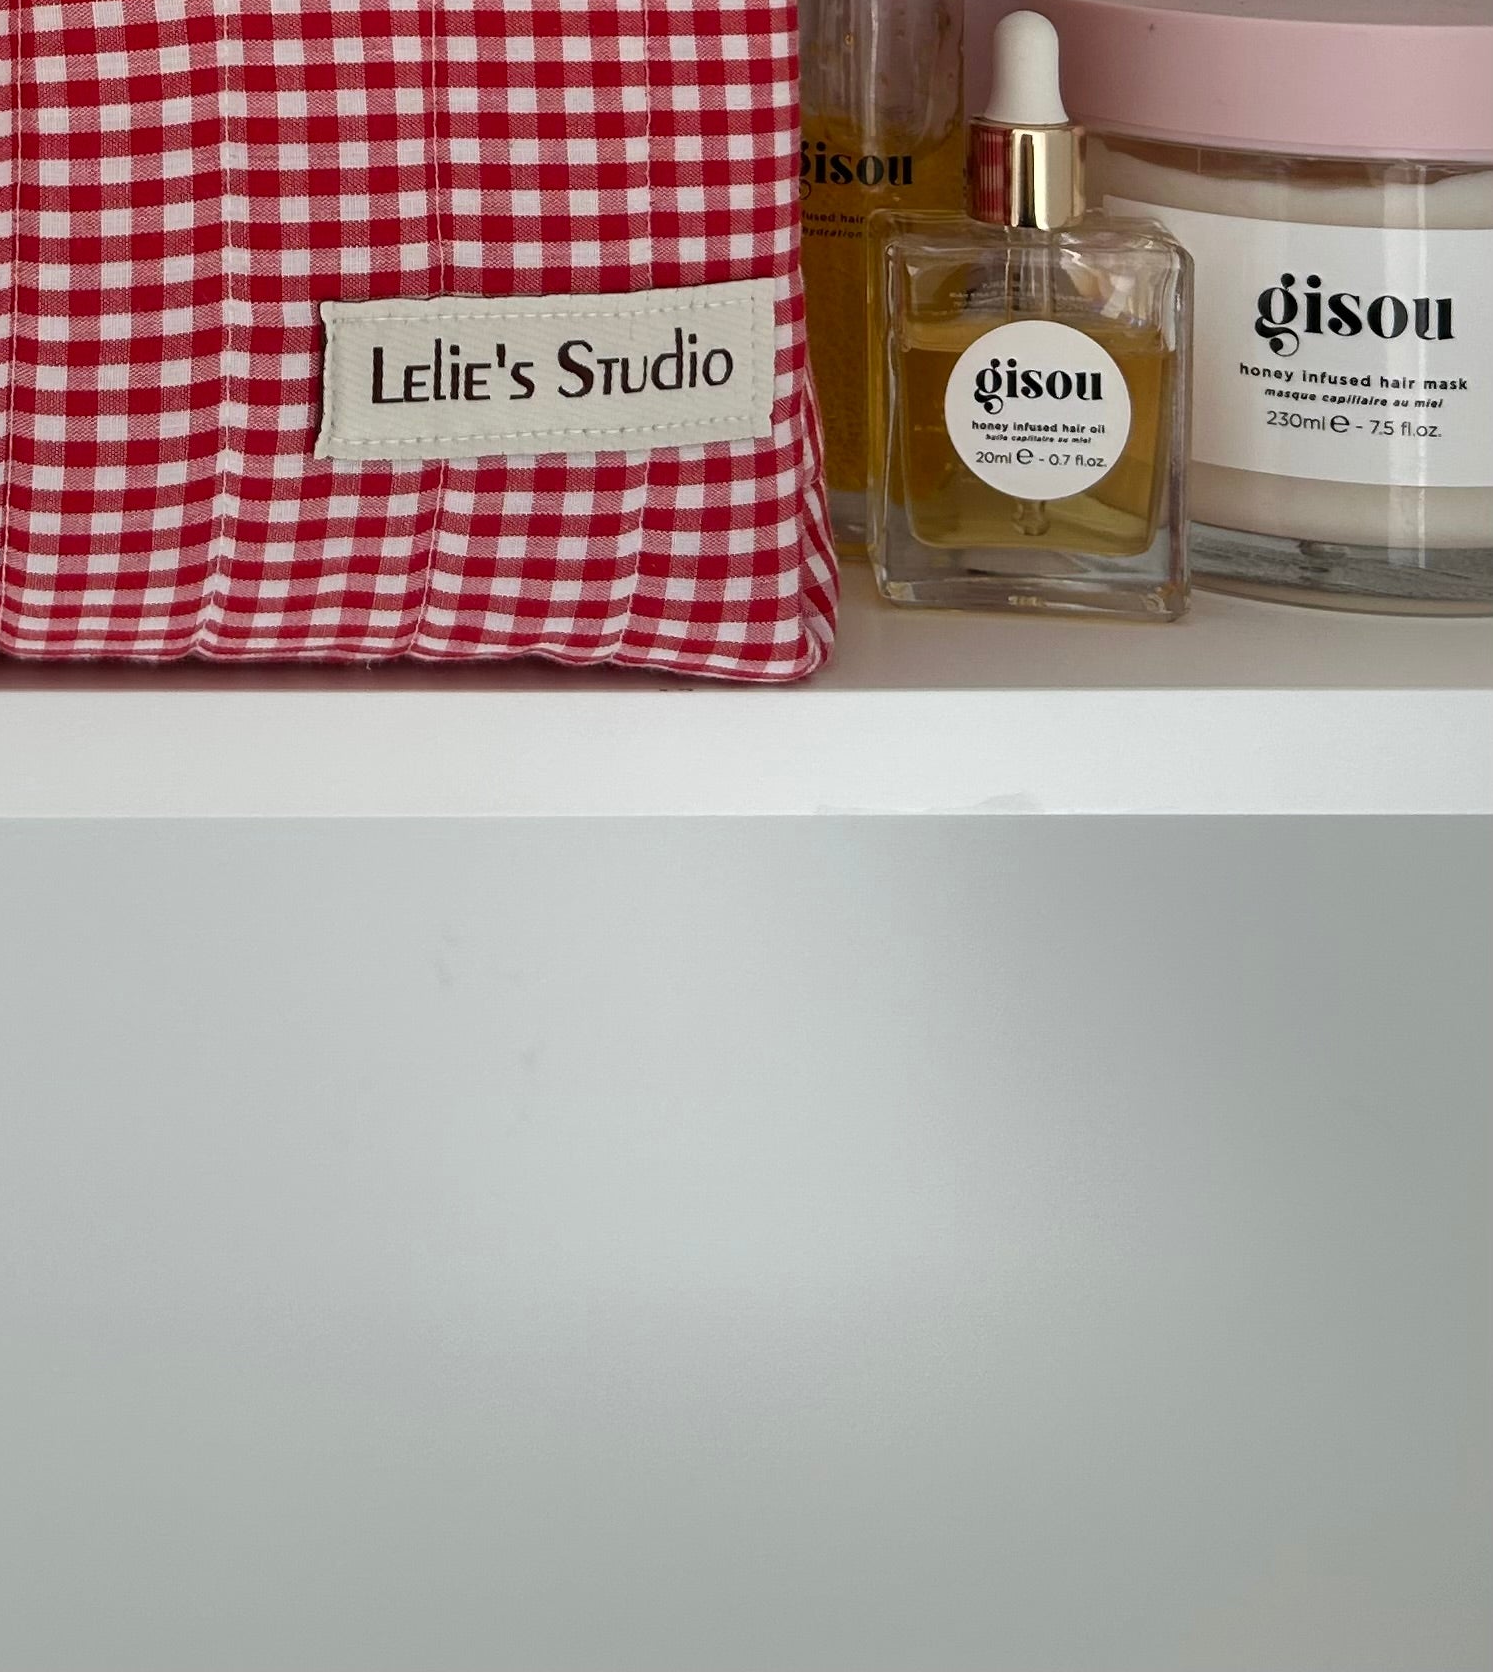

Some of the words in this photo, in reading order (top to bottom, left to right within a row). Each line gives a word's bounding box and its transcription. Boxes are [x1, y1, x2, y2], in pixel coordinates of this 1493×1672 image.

[840, 212, 865, 224] hair
[1254, 272, 1455, 358] gisou
[370, 338, 536, 405] Lelie's
[557, 326, 734, 399] Studio
[1239, 362, 1294, 382] honey
[1302, 370, 1371, 387] infused
[1379, 375, 1415, 389] hair
[1423, 377, 1468, 391] mask
[974, 358, 1103, 415] gisou
[1264, 387, 1317, 402] masque
[1322, 393, 1388, 407] capillaire
[1392, 399, 1408, 408] au
[1414, 399, 1443, 409] miel
[971, 420, 1009, 433] honey
[1013, 421, 1057, 434] infused
[1062, 423, 1085, 434] hair
[1090, 424, 1105, 434] oil
[1266, 410, 1326, 431] 230ml
[1369, 419, 1395, 436] 7.5
[1011, 434, 1054, 443] capillaire
[975, 451, 1012, 464] 20ml
[1048, 453, 1071, 466] 0.7
